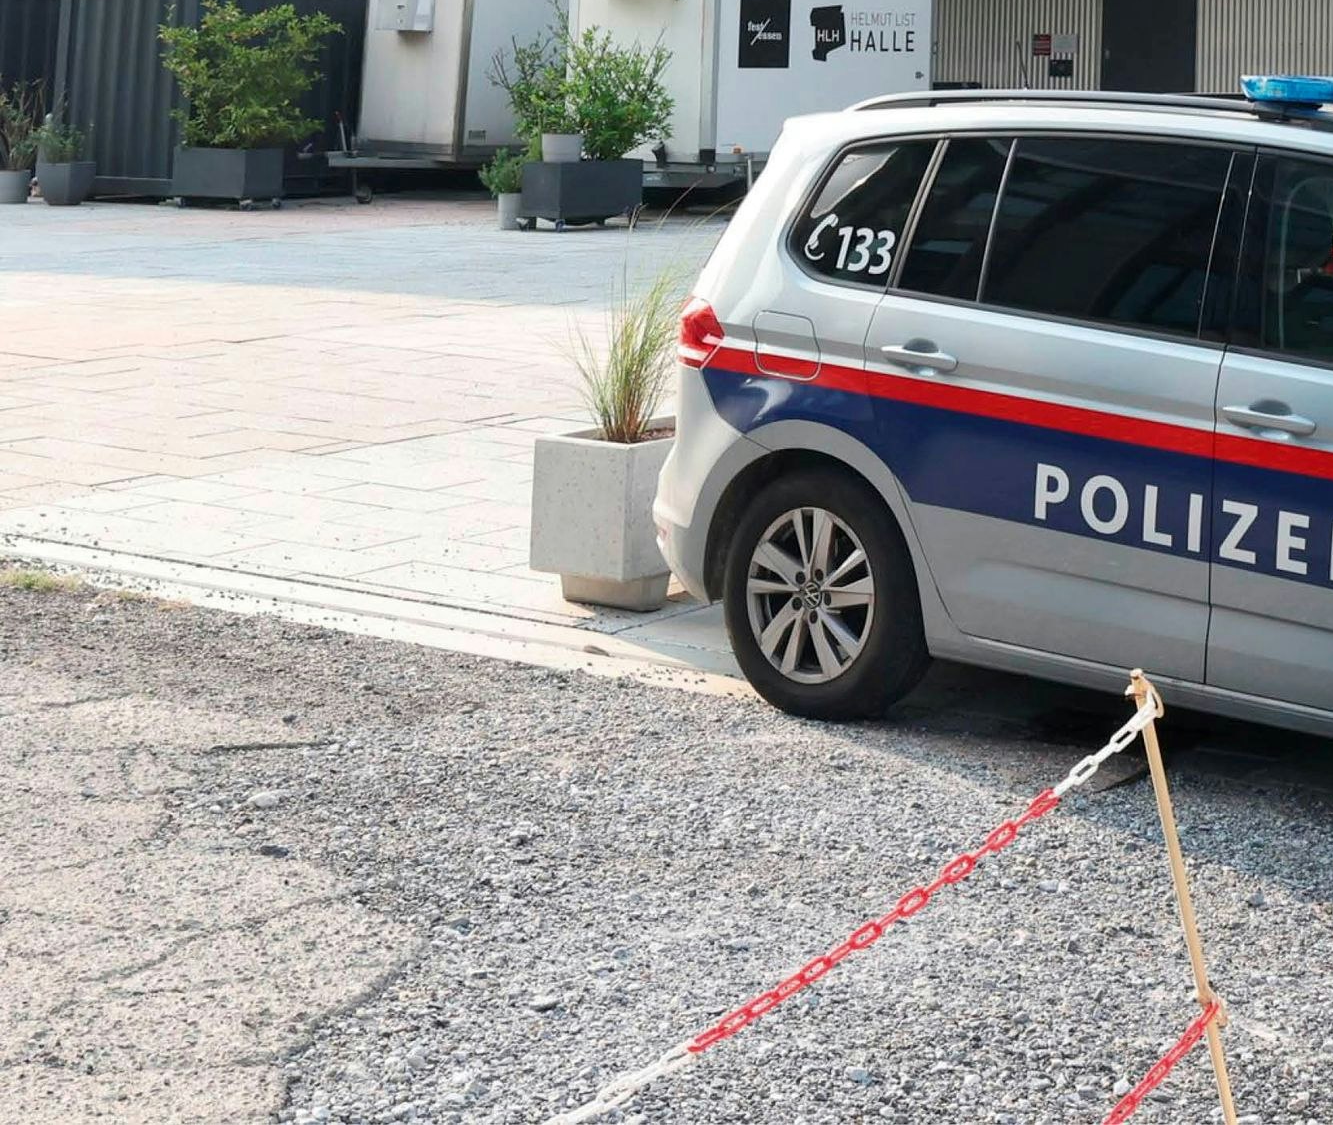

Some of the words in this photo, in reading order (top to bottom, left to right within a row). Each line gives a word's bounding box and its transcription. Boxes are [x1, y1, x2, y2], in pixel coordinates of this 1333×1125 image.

[850, 12, 892, 27] HELMUT
[895, 12, 916, 27] LIST
[816, 29, 840, 43] HLH
[850, 29, 915, 52] HALLE
[835, 223, 897, 275] 133
